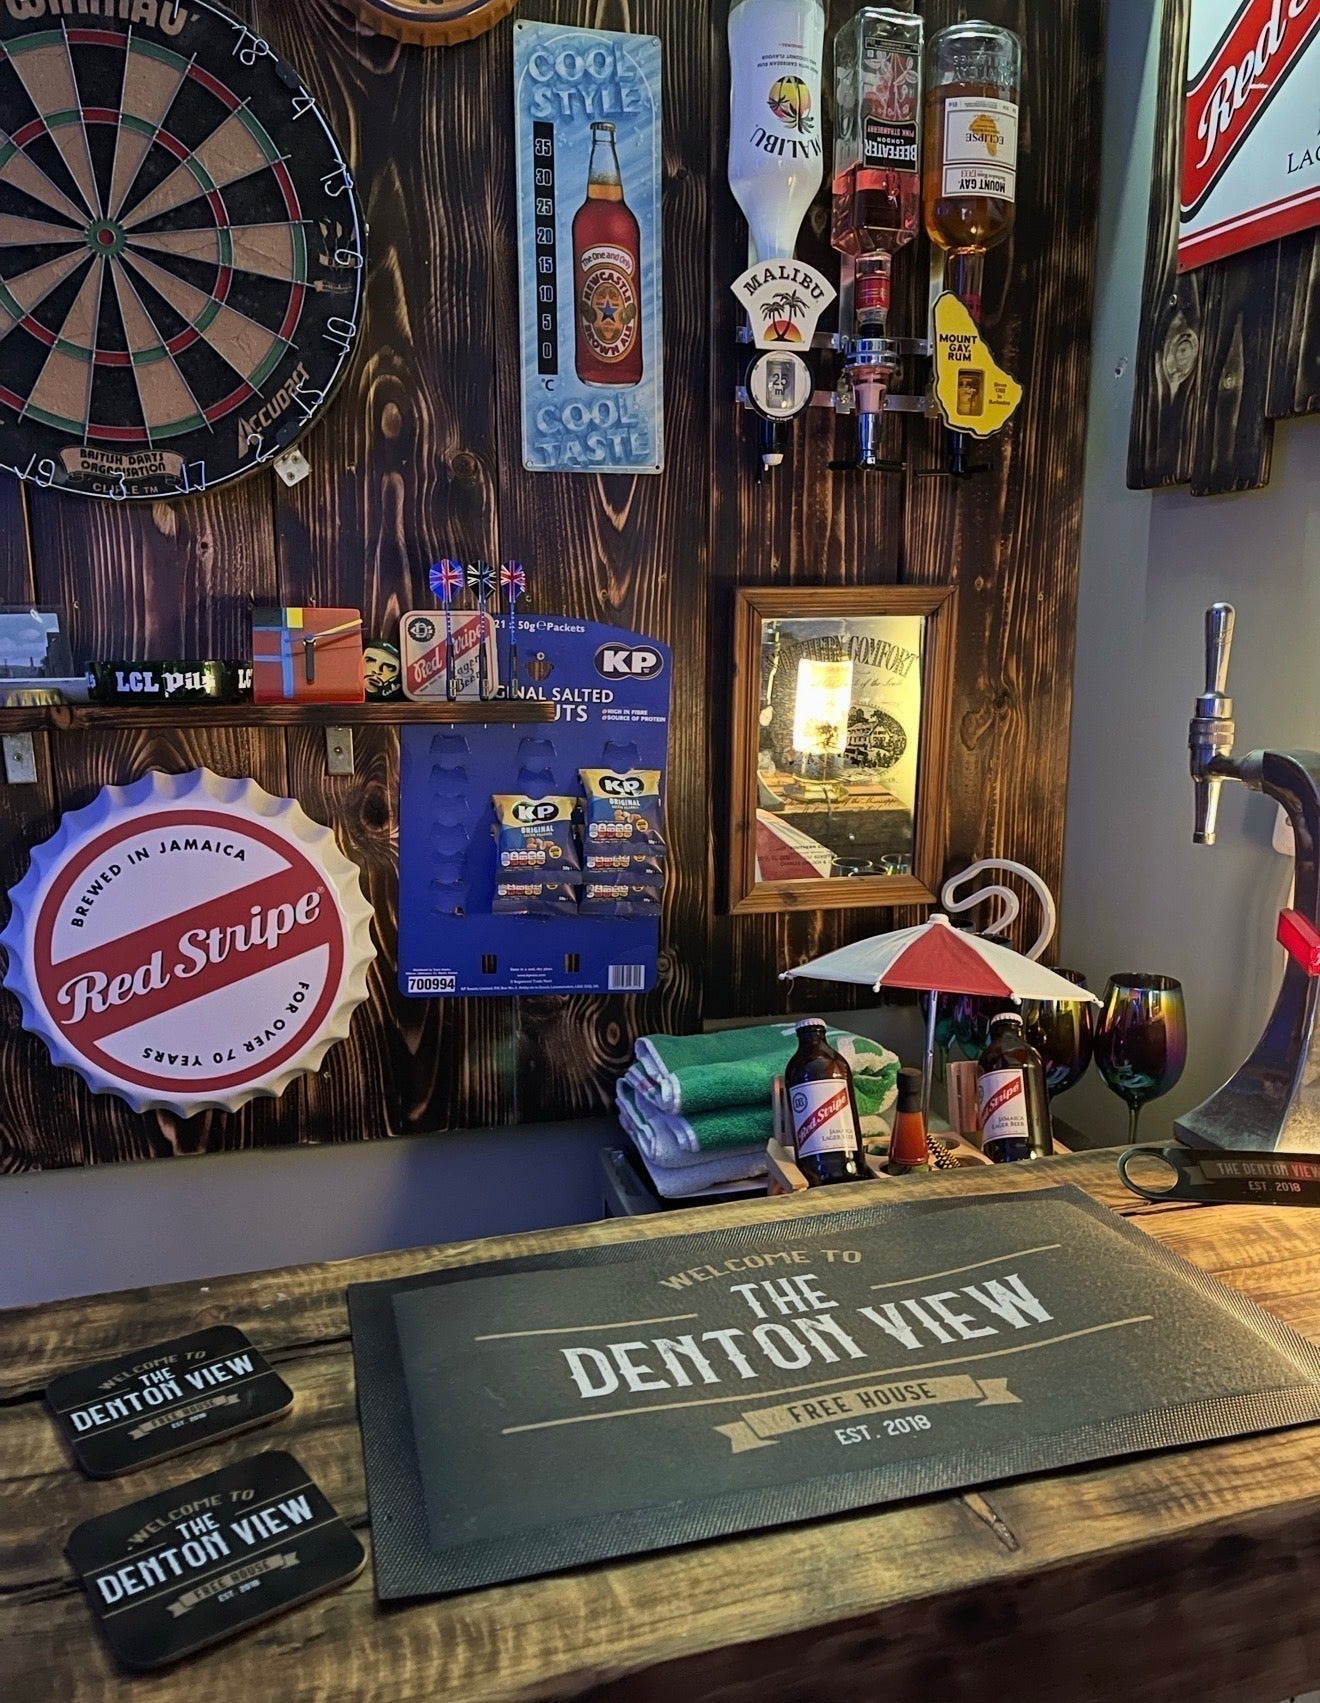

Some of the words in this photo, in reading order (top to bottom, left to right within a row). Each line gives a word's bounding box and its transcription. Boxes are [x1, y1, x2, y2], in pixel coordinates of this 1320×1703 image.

[231, 25, 270, 66] 18
[528, 43, 636, 82] COOL
[530, 84, 642, 117] STYLE
[535, 139, 552, 156] 35
[749, 127, 822, 159] MALIBU
[864, 138, 918, 161] BEEFEATER
[965, 133, 1005, 145] ECLIPSE
[535, 168, 552, 186] 30
[958, 178, 977, 190] GAY
[978, 179, 1006, 193] MOUNT
[536, 199, 552, 215] 25
[537, 228, 553, 245] 20
[538, 257, 553, 274] 15
[583, 271, 632, 304] NEWCASTLE
[742, 265, 825, 300] MALIBU
[539, 286, 554, 303] 10
[542, 314, 551, 331] 5
[542, 342, 552, 359] 0
[584, 324, 620, 355] BROWN
[620, 325, 633, 347] ALE
[939, 334, 978, 345] MOUNT
[947, 352, 972, 362] RUM
[772, 373, 788, 386] 25
[535, 393, 639, 435] COOL
[80, 448, 123, 466] BRITISH
[128, 452, 164, 466] DARTS
[535, 430, 650, 469] TASTE
[517, 620, 536, 633] 50g
[546, 622, 586, 633] Packets
[413, 646, 443, 683] Red
[457, 654, 481, 680] ager
[602, 649, 657, 674] KP
[847, 636, 919, 678] COMFORT
[115, 671, 159, 692] LCL
[552, 687, 614, 704] SALTED
[604, 779, 640, 793] KP
[518, 805, 555, 819] KP
[609, 798, 641, 807] ORIGINAL
[521, 825, 554, 834] ORIGINAL
[71, 863, 122, 928] BREWED
[127, 847, 150, 865] IN
[160, 838, 246, 861] JAMAICA
[57, 951, 171, 1025] Red
[174, 890, 321, 979] Stripe
[408, 978, 455, 991] 700994
[286, 981, 310, 1014] FOR
[243, 1018, 286, 1053] OVER
[142, 1046, 203, 1067] YEARS
[212, 1048, 237, 1065] 70
[990, 1081, 1019, 1108] Stripe
[816, 1092, 847, 1123] Stripe
[1216, 1162, 1241, 1175] THE
[1243, 1163, 1290, 1177] DENTON
[1276, 1181, 1301, 1192] 2018
[658, 1248, 811, 1291] WELCOME
[821, 1248, 862, 1263] TO
[730, 1273, 840, 1320] THE
[558, 1312, 868, 1399] DENTON
[857, 1273, 1055, 1351] VIEW
[97, 1353, 178, 1391] WELCOME
[184, 1351, 206, 1361] TO
[137, 1367, 176, 1387] THE
[69, 1379, 184, 1432] DENTON
[184, 1354, 254, 1391] VIEW
[788, 1397, 856, 1424] FREE
[861, 1382, 937, 1409] HOUSE
[150, 1413, 177, 1428] FREE
[834, 1427, 883, 1447] EST.
[886, 1415, 932, 1435] 2018
[127, 1494, 223, 1544] WELCOME
[229, 1489, 255, 1503] TO
[175, 1512, 220, 1540] THE
[96, 1531, 231, 1605] DENTON
[229, 1494, 314, 1545] VIEW
[193, 1579, 225, 1600] FREE
